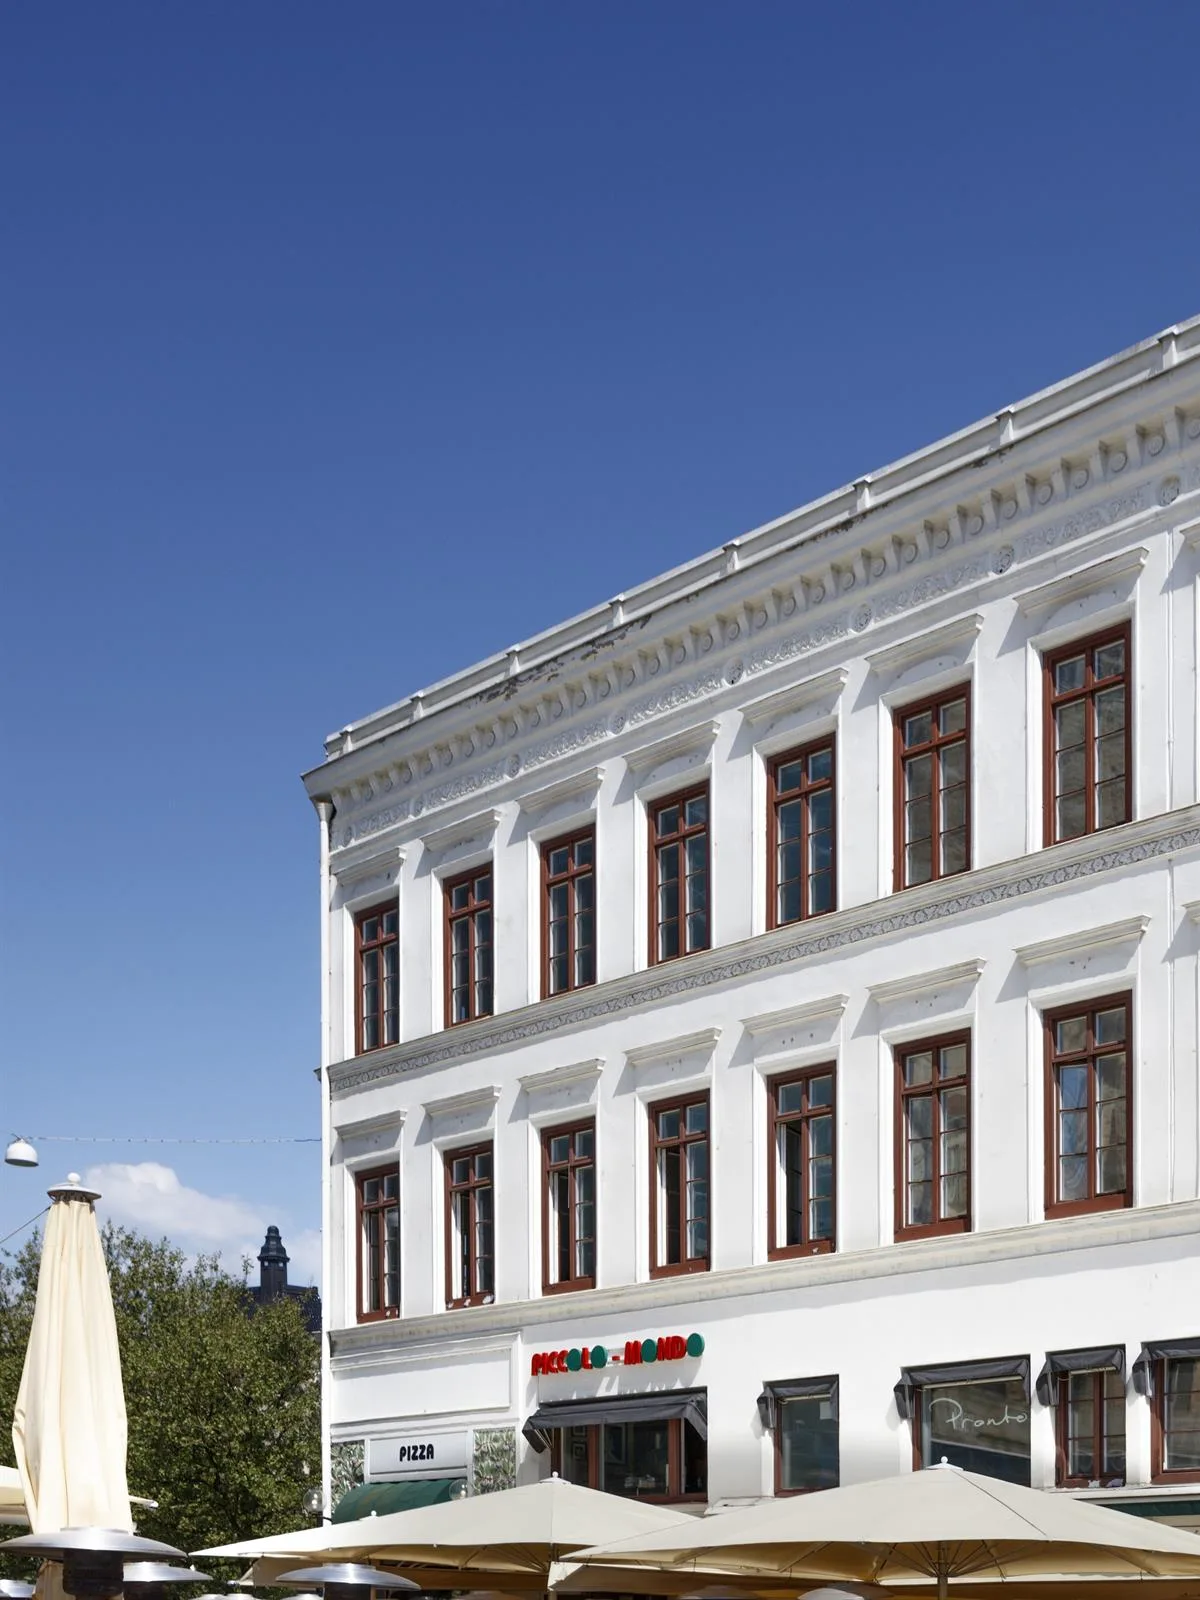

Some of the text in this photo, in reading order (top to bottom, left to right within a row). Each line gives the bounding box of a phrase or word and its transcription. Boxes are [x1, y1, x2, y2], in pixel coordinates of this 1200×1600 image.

[531, 1345, 608, 1376] PICCOLO
[624, 1333, 705, 1365] MONDO
[929, 1397, 1027, 1429] Pronto
[400, 1443, 434, 1462] PIZZA
